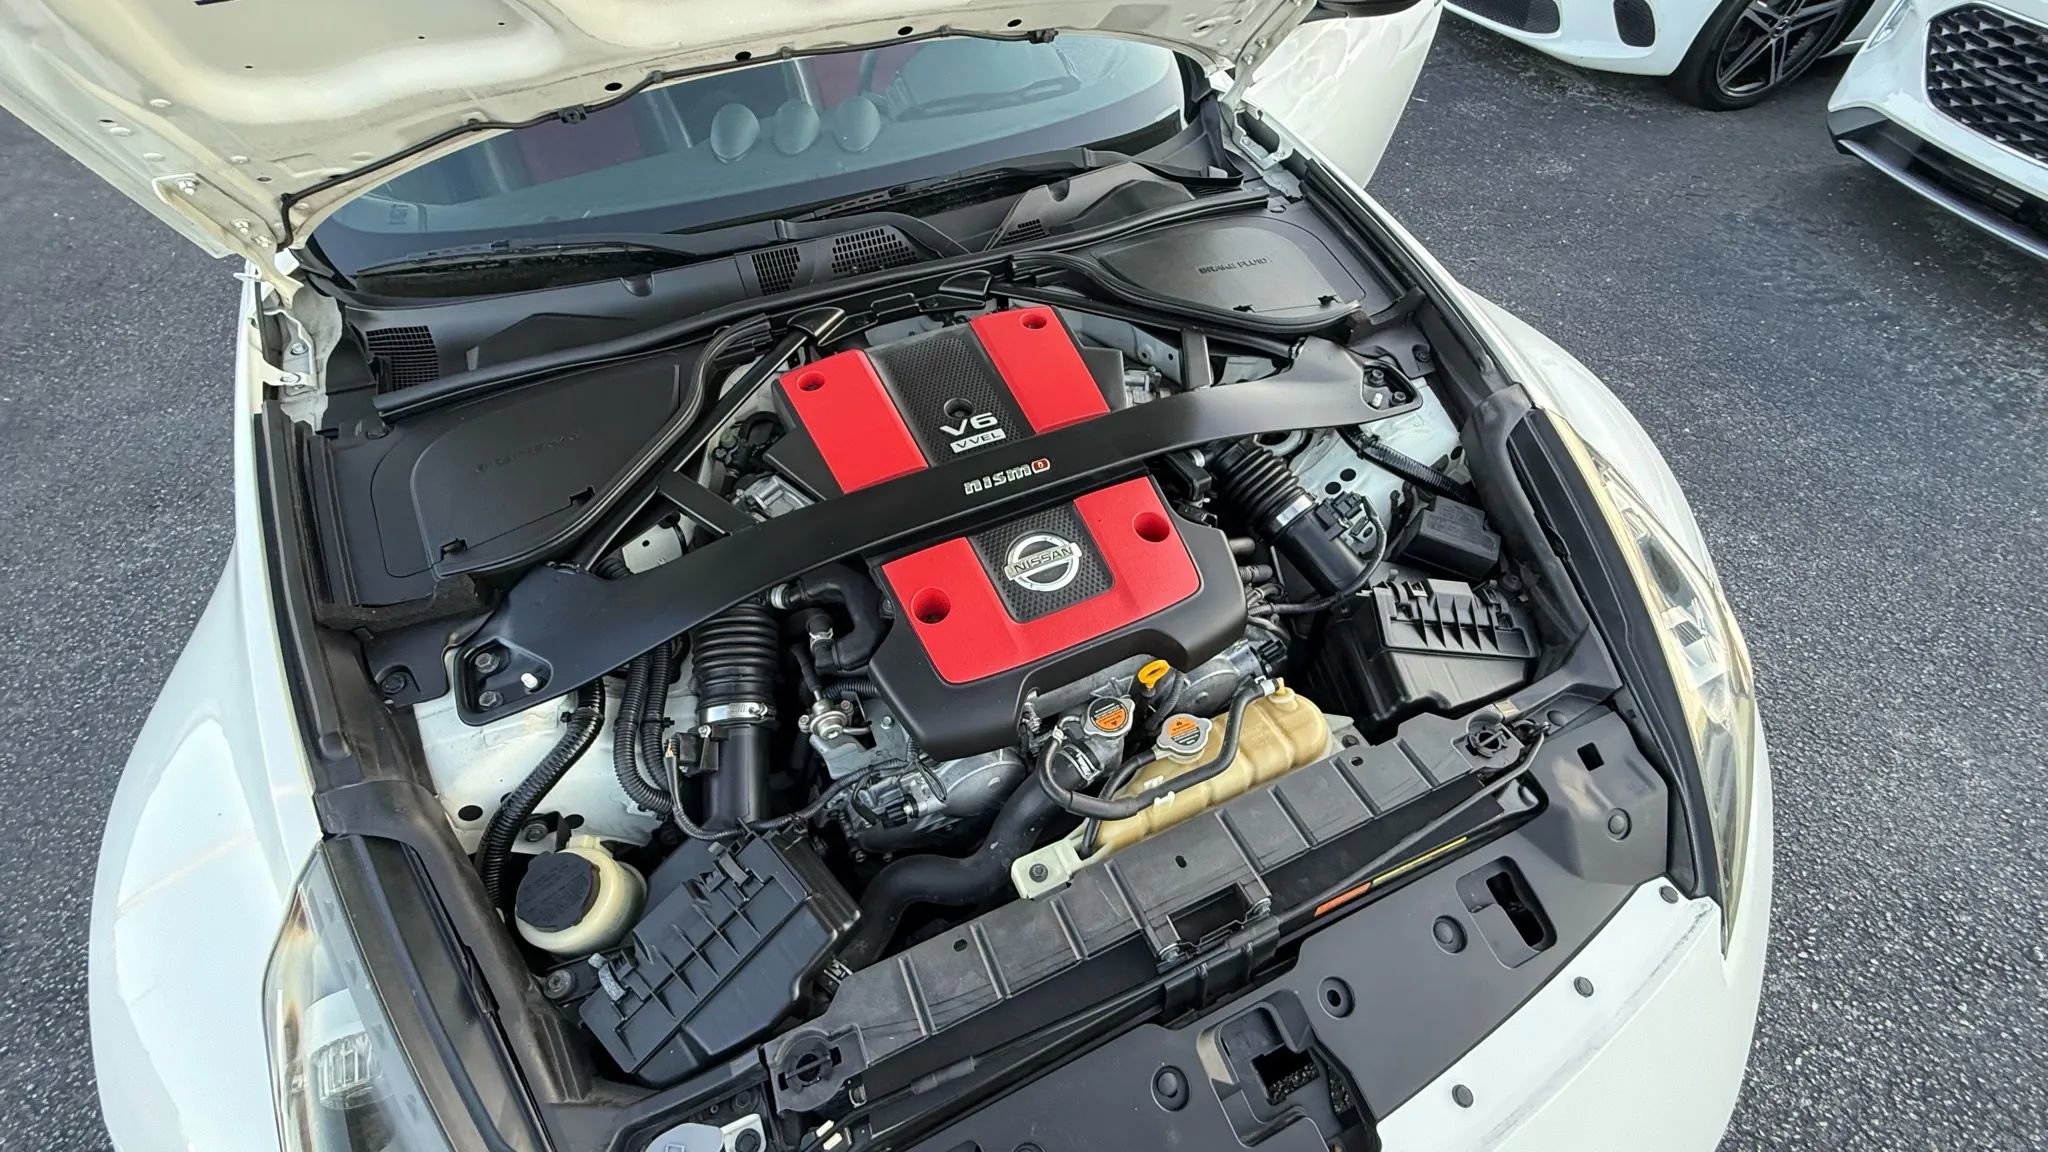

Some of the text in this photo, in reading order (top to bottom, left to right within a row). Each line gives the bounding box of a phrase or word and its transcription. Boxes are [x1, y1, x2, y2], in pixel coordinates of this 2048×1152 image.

[940, 412, 998, 437] V6
[955, 431, 1002, 449] VVEL
[1012, 546, 1074, 574] NISSAN
